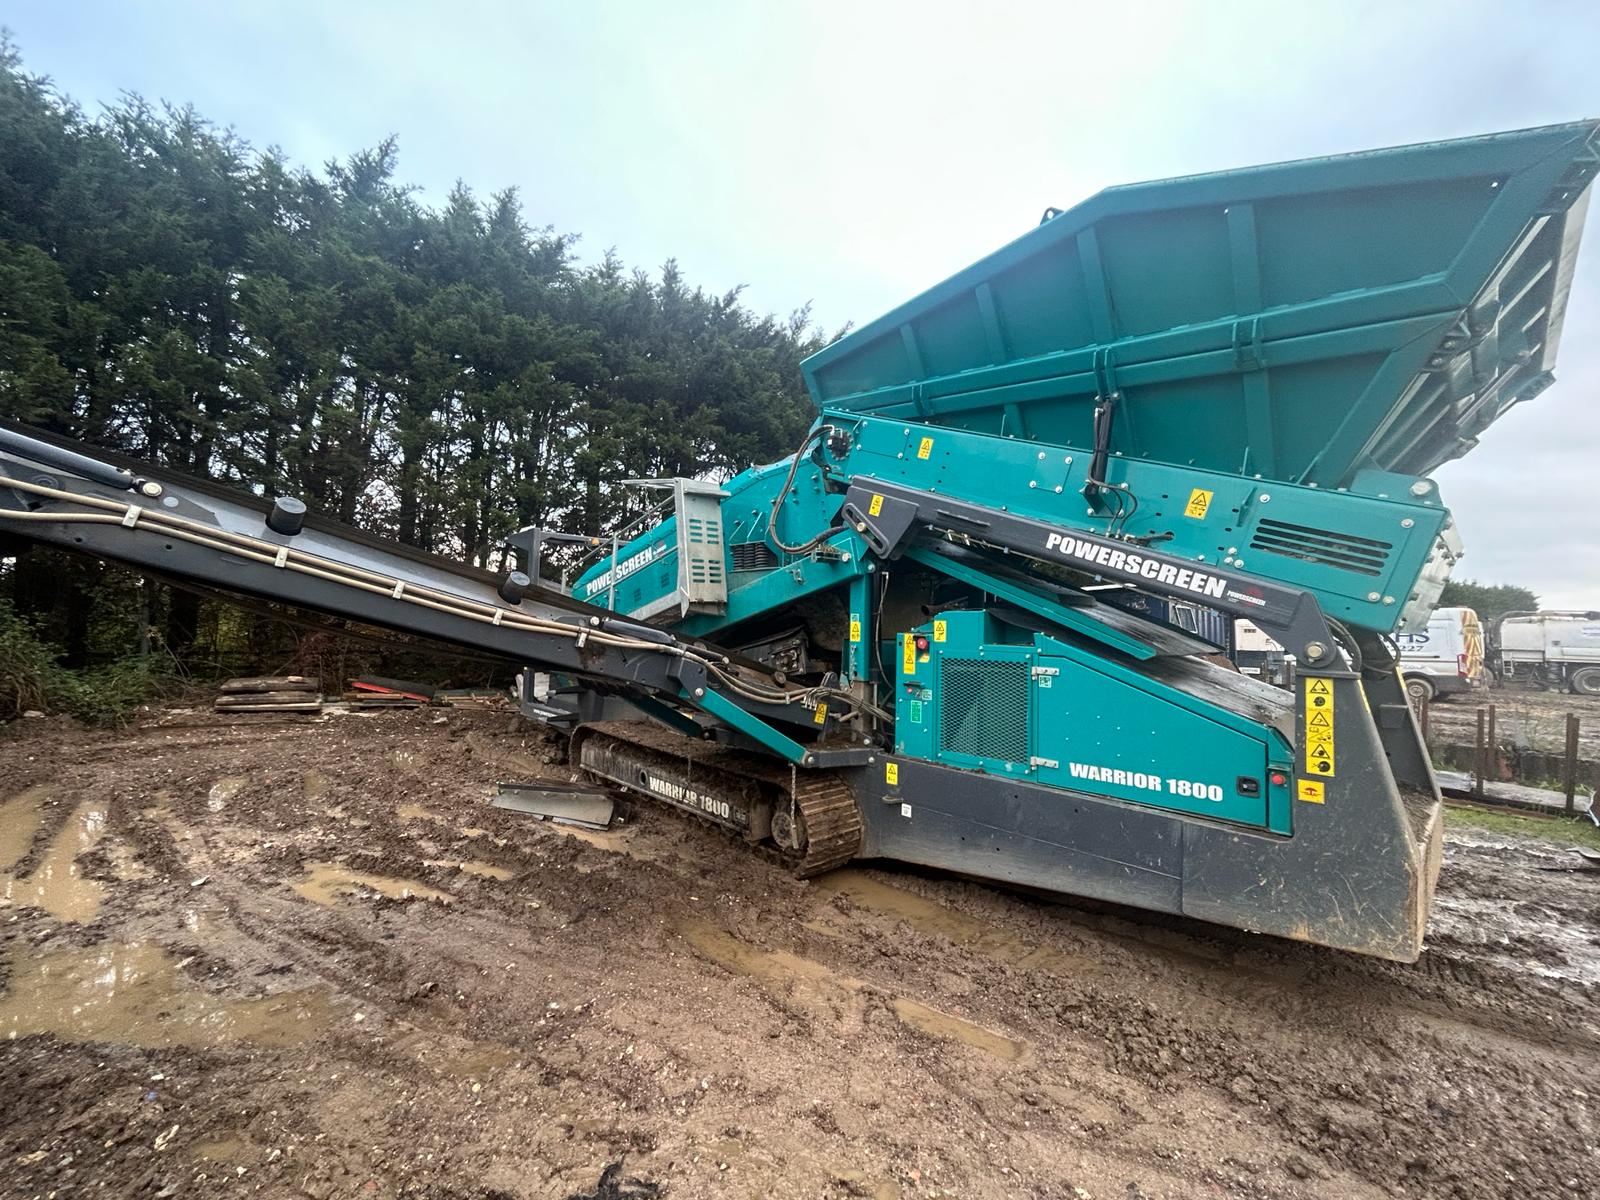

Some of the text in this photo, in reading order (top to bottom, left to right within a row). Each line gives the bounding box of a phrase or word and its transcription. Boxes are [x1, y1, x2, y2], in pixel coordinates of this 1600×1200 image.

[586, 546, 653, 596] POWESCREEN
[1045, 532, 1227, 598] POWERSCREEN
[1069, 762, 1223, 802] WARRIOR 1800
[699, 795, 730, 819] 1800
